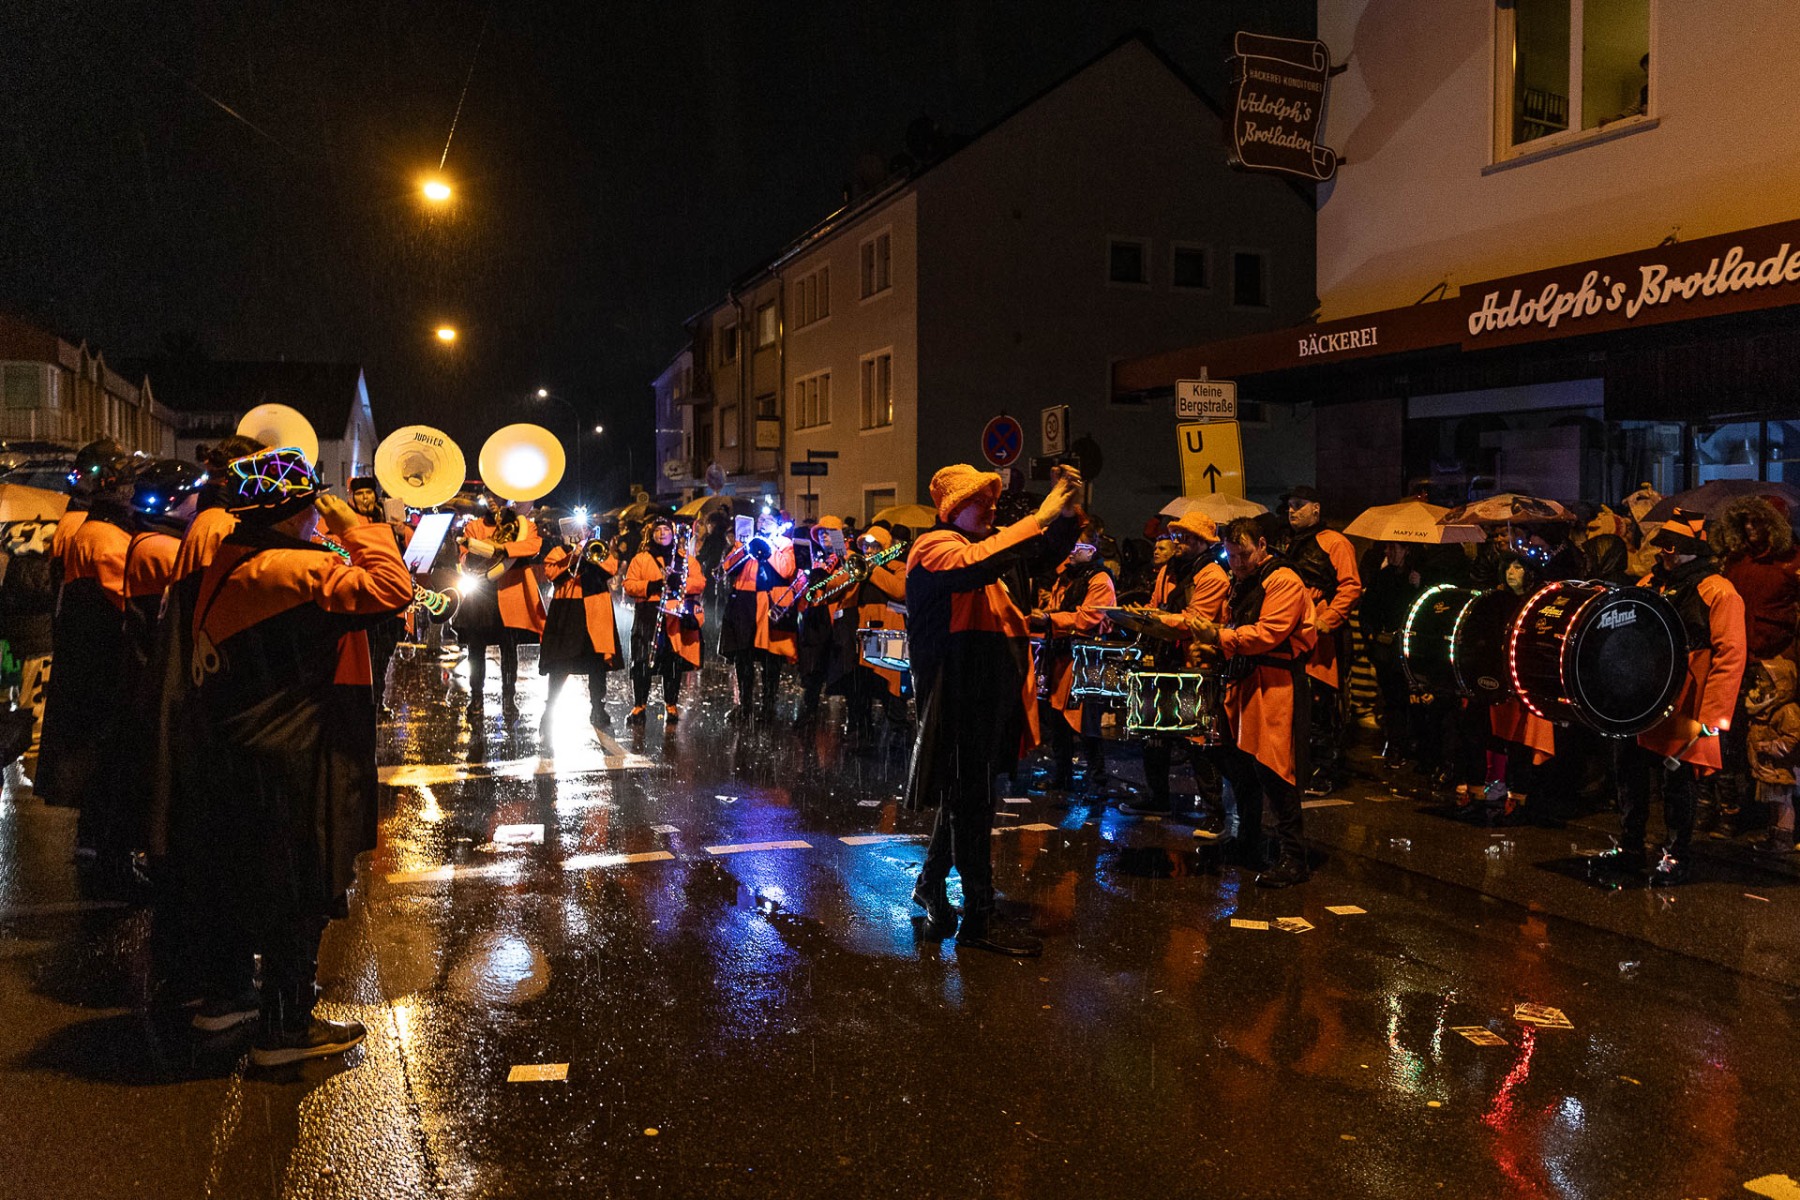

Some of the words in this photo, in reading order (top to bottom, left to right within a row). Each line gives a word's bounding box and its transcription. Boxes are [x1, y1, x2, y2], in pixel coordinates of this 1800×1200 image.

[1241, 92, 1312, 122] Adolph's
[1241, 121, 1311, 153] Brotladen
[1468, 270, 1626, 336] Adolph's
[1298, 326, 1378, 357] BÄCKEREI
[1192, 384, 1222, 397] Kleine
[1179, 398, 1233, 415] Bergstraße
[1186, 430, 1204, 453] U
